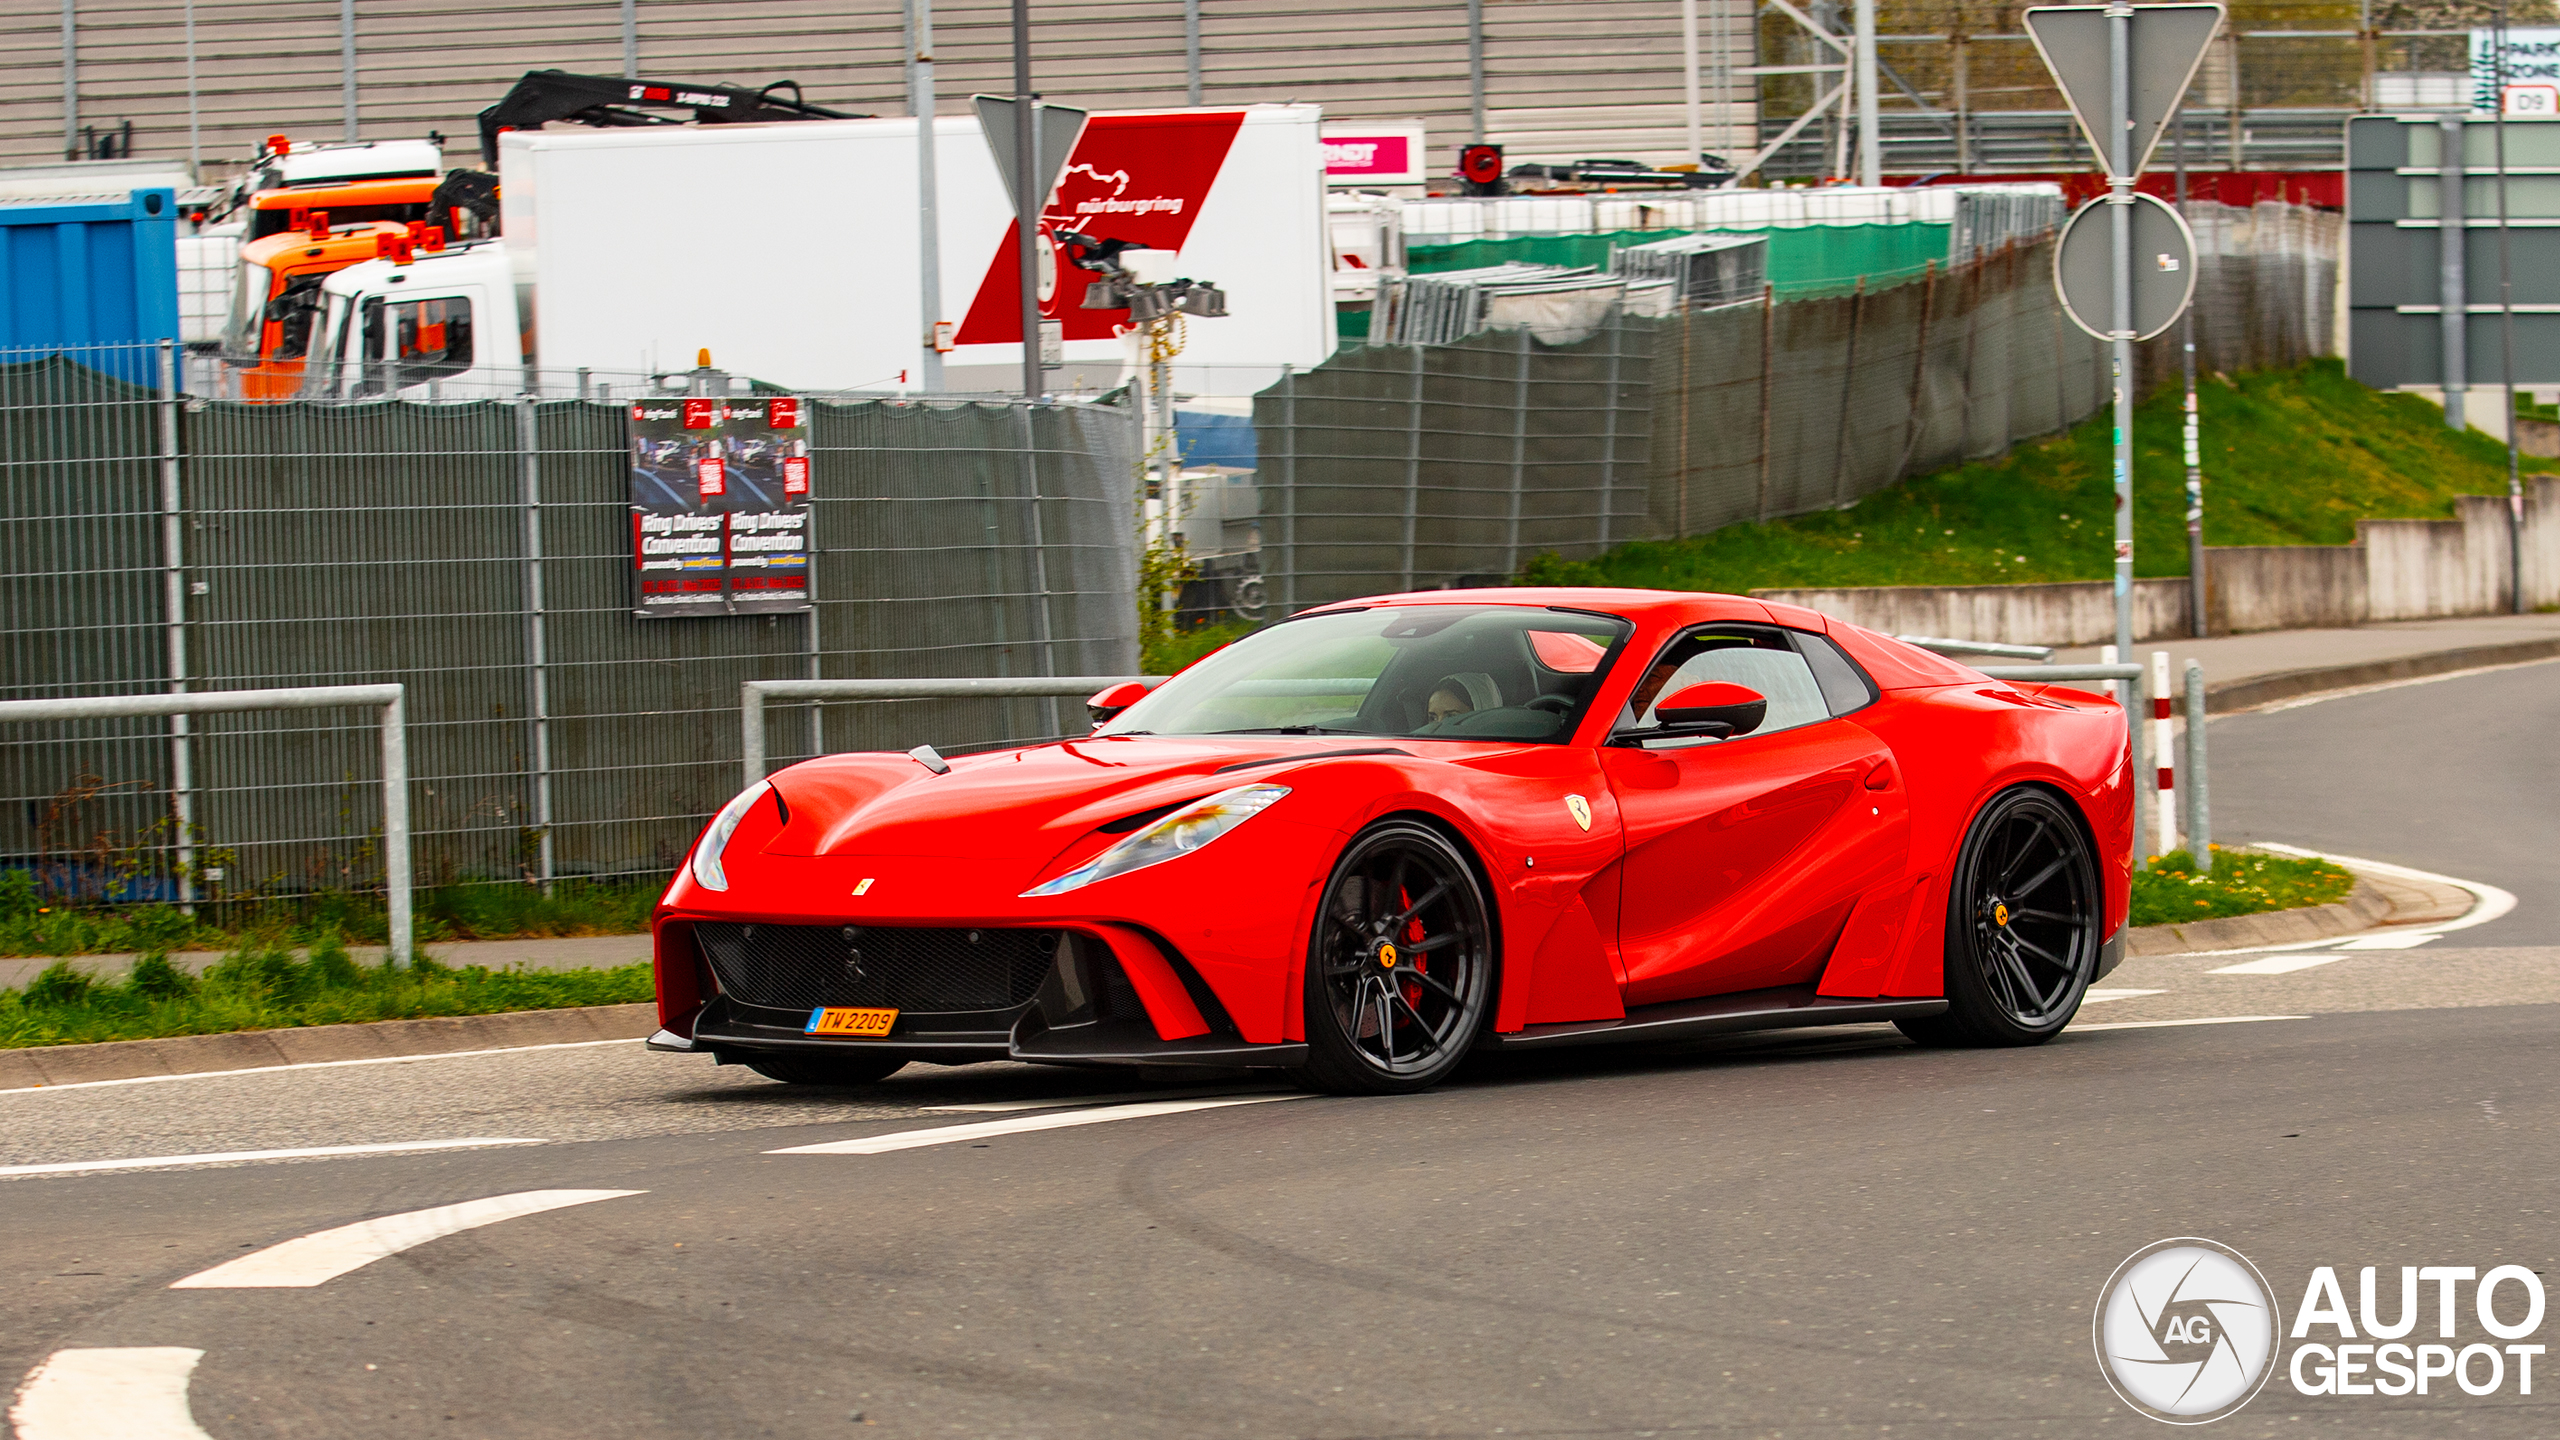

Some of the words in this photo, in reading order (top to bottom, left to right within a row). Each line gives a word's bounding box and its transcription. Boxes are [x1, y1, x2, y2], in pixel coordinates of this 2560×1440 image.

[2518, 94, 2544, 110] D9
[1075, 195, 1184, 216] nürburgring
[641, 512, 674, 537] Ring
[729, 510, 760, 534] Ring
[641, 532, 721, 556] Convention
[730, 530, 804, 552] Convention
[823, 1012, 846, 1028] TW
[845, 1013, 891, 1030] 2209
